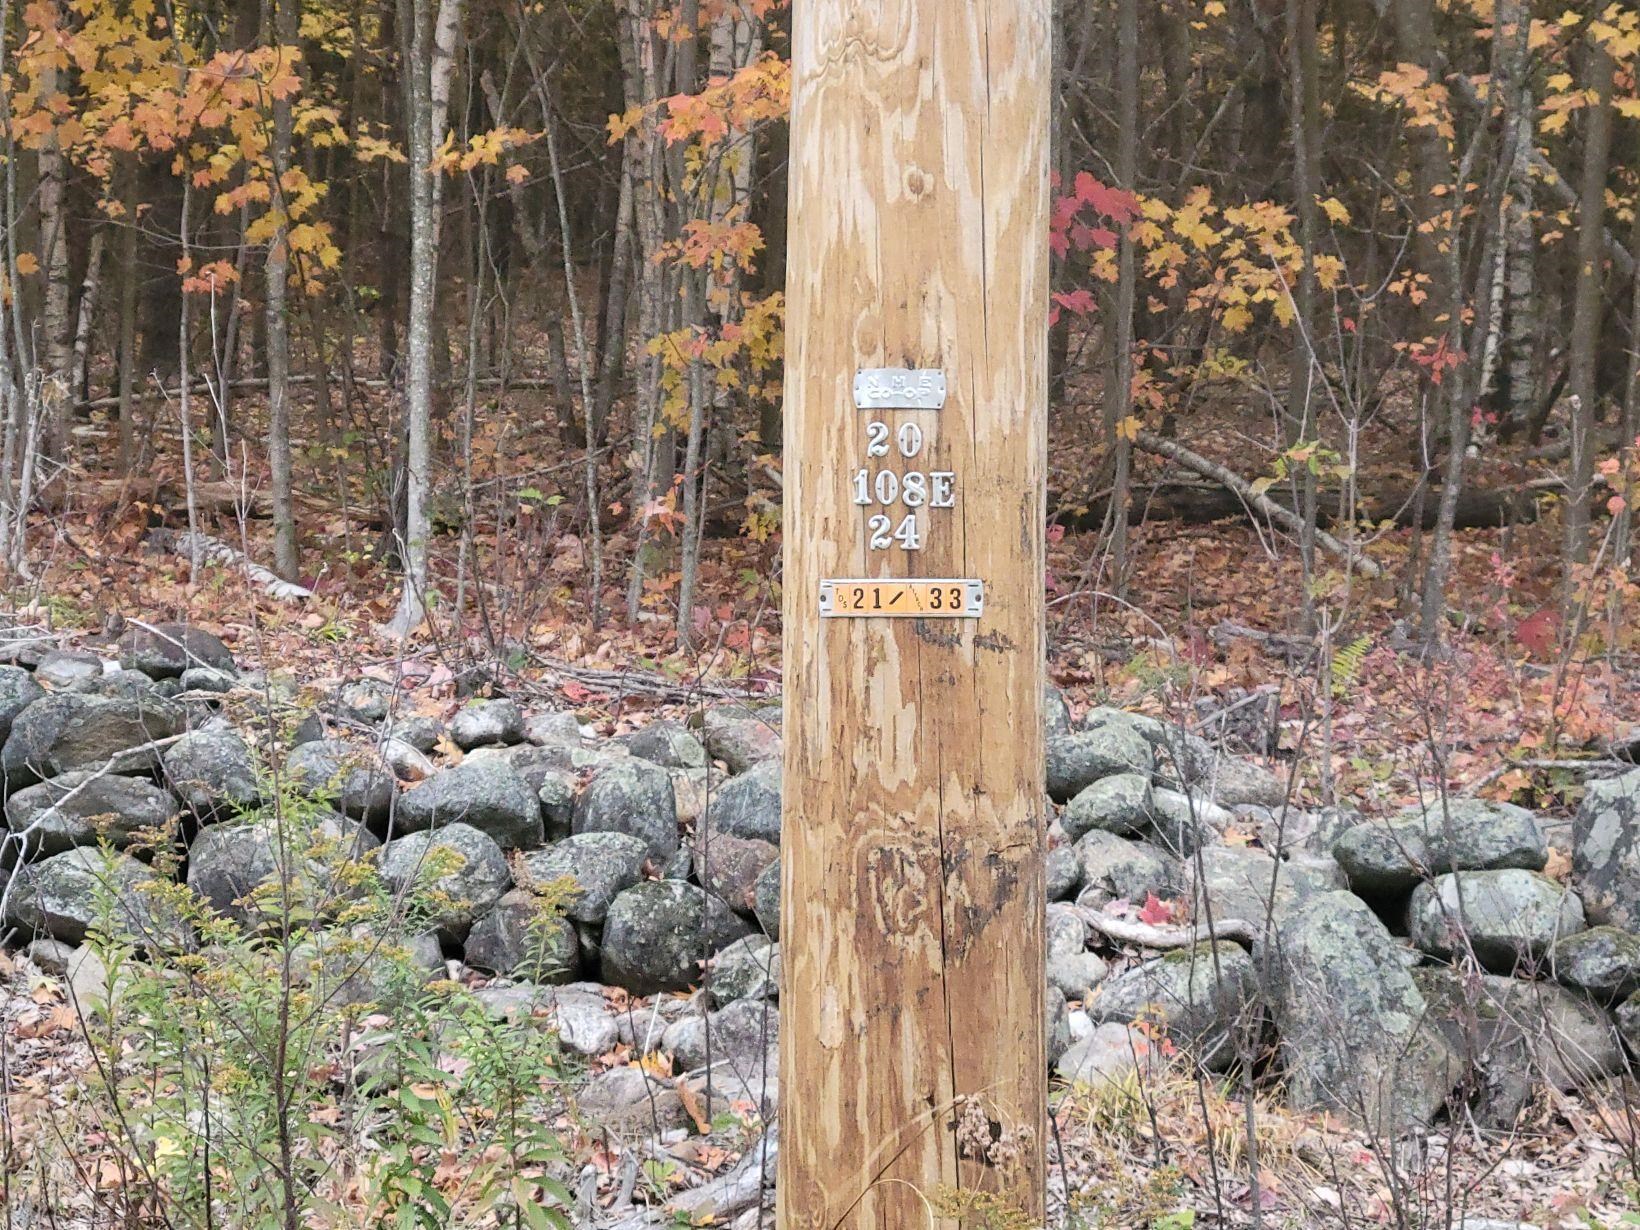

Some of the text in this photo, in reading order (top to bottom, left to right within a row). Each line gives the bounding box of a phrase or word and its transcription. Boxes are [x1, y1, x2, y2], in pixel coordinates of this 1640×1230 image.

[867, 422, 922, 457] 20
[853, 469, 956, 508] 108E
[868, 514, 920, 550] 24
[930, 587, 962, 609] 33
